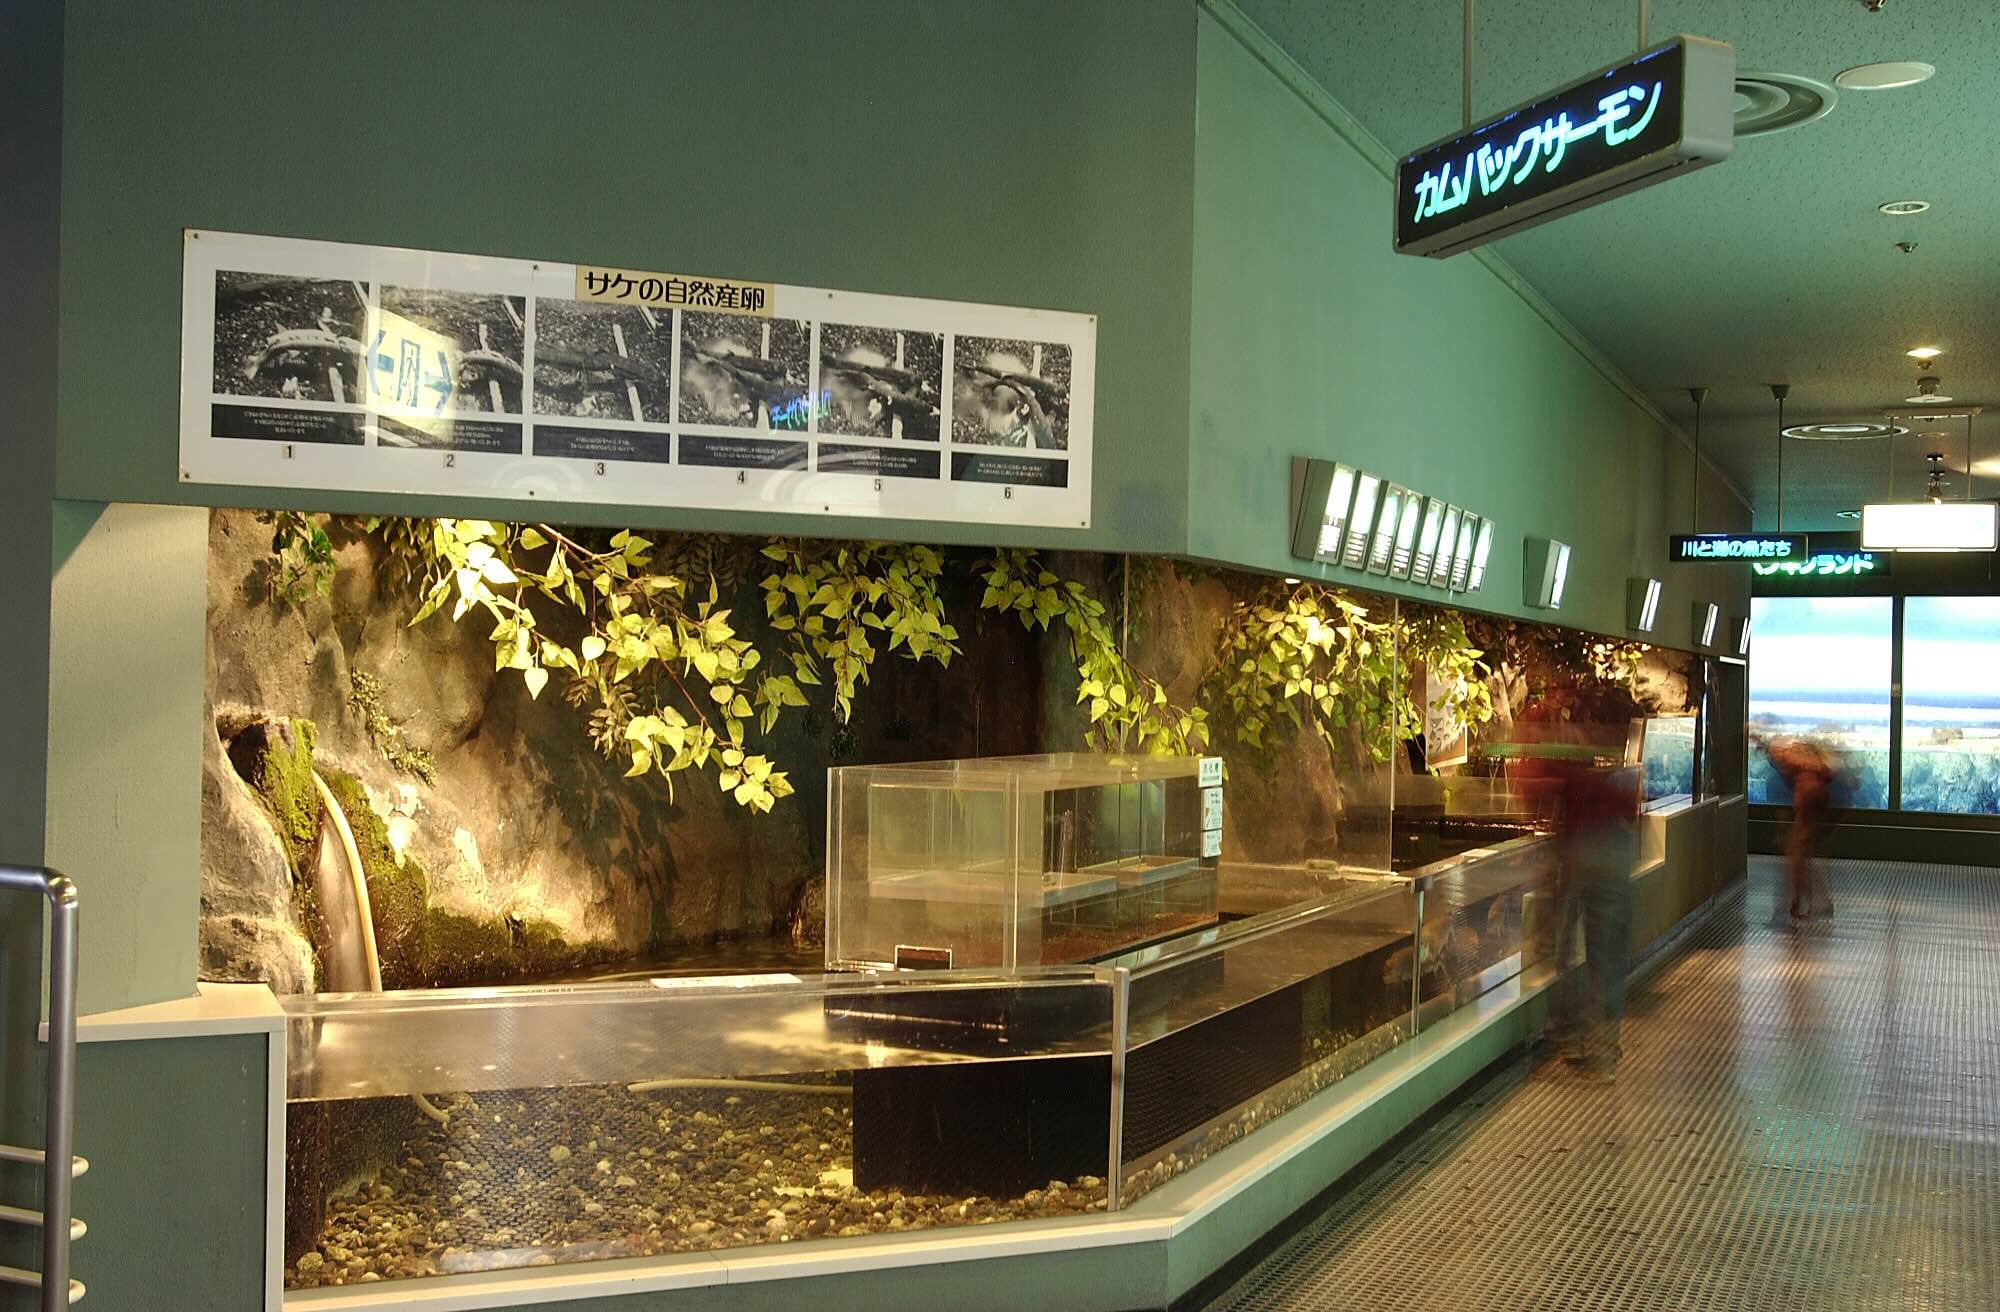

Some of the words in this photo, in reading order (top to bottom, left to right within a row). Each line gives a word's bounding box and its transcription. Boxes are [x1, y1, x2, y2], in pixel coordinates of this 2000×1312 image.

[1414, 80, 1662, 224] カムバックサーモン
[584, 271, 765, 312] サケの自然産卵
[286, 445, 293, 459] 1
[445, 454, 455, 468] 2
[596, 462, 605, 476] 3
[737, 470, 746, 484] 4
[873, 478, 882, 492] 5
[1004, 487, 1012, 500] 6
[1681, 540, 1792, 558] 川と湖の魚たち
